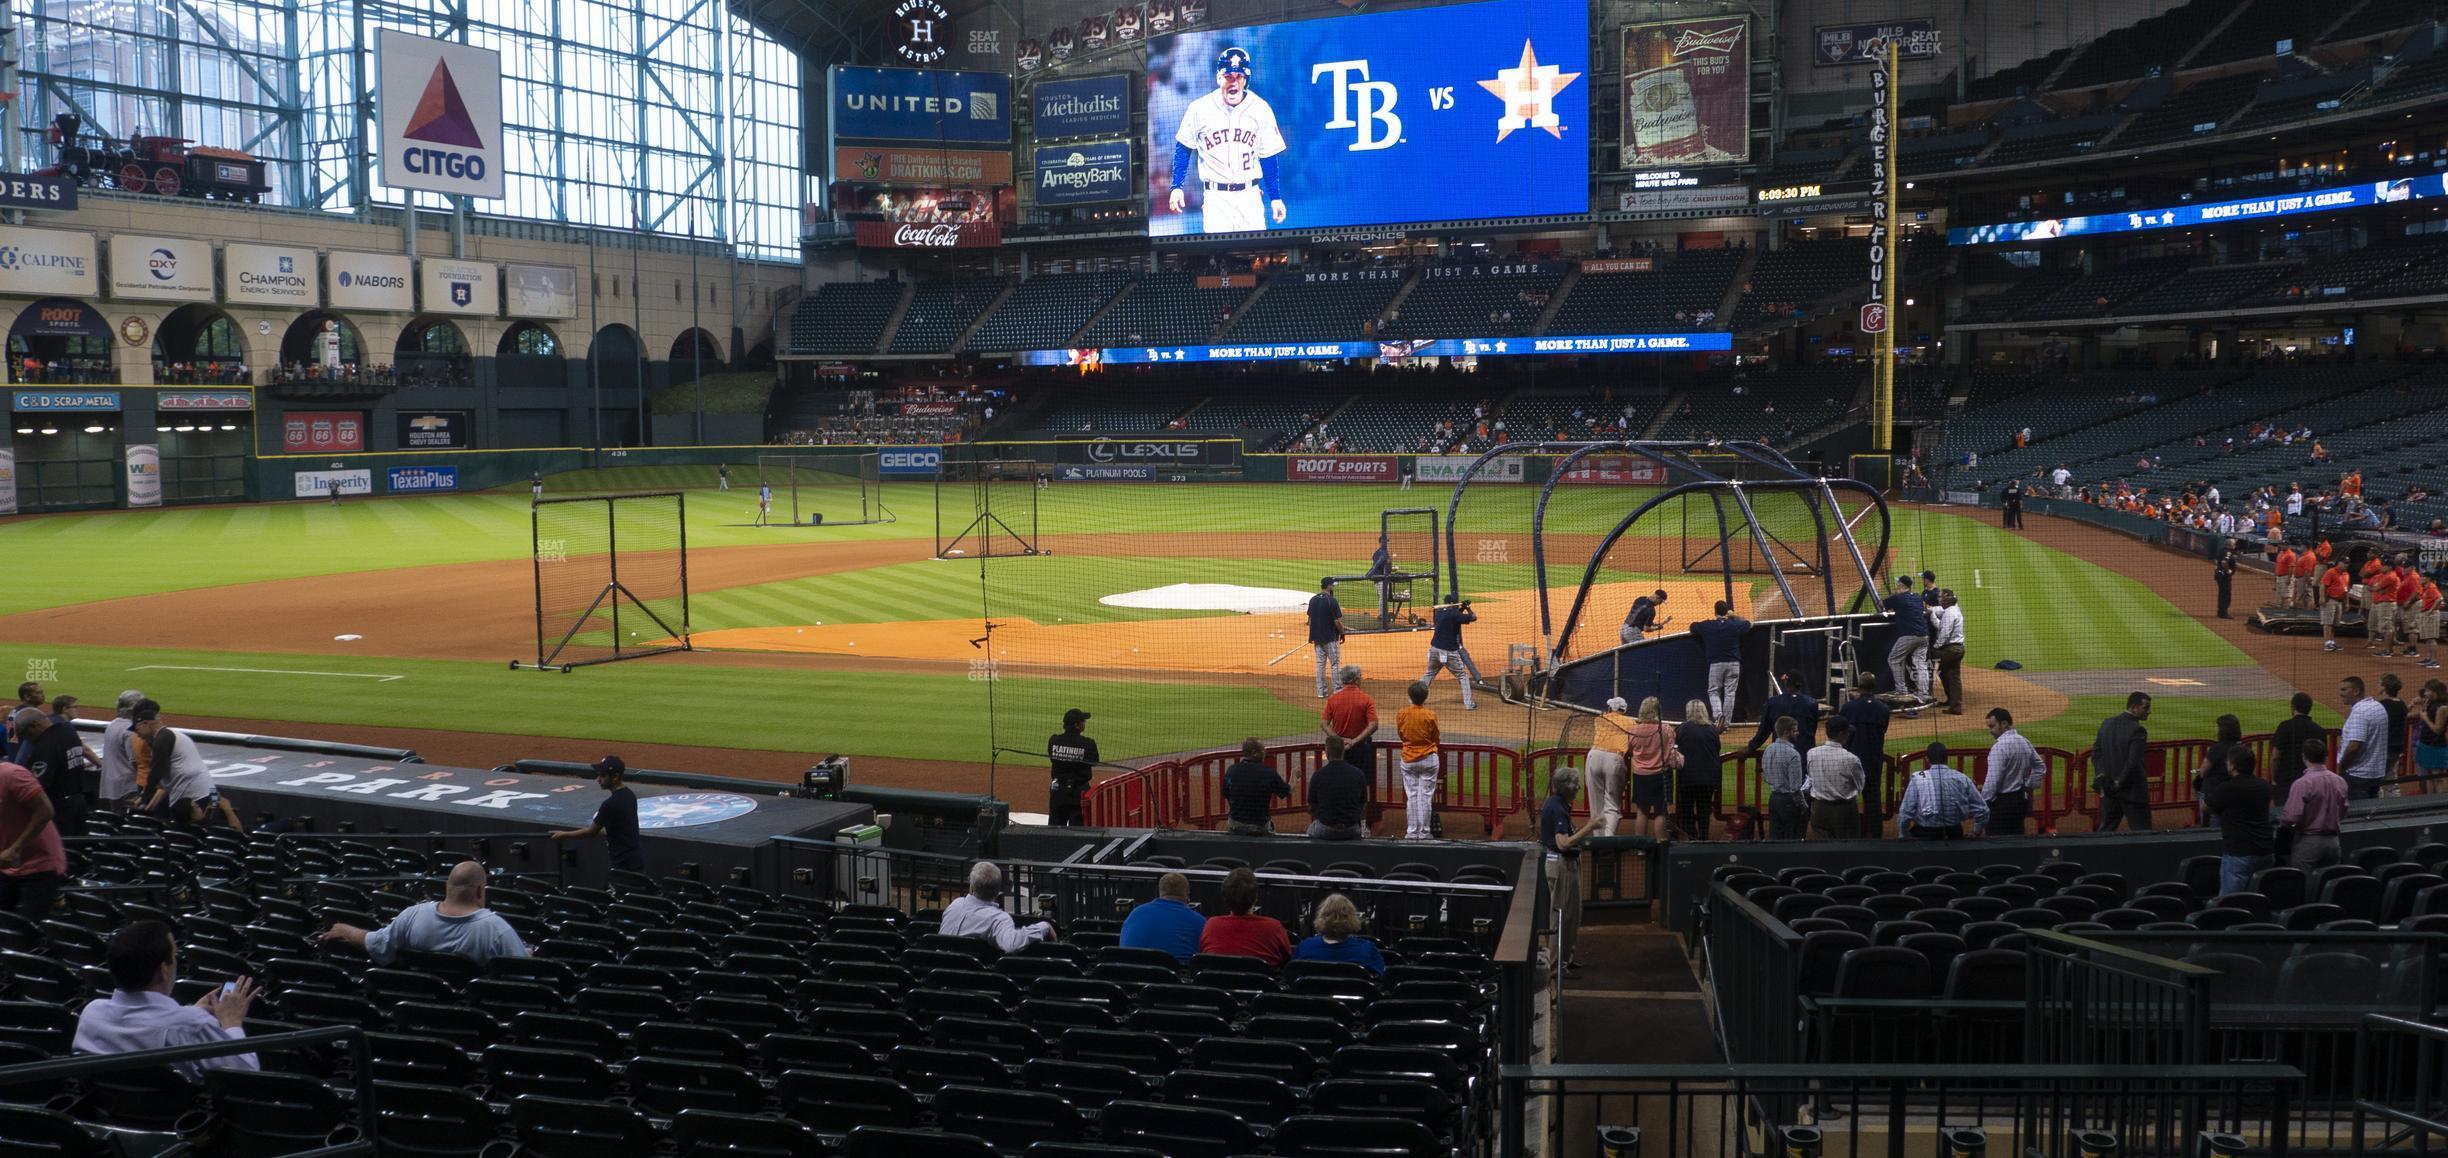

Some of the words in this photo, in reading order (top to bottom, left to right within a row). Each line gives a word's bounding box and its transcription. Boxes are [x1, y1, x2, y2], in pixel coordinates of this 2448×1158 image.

[895, 0, 948, 19] HOUSTON
[1115, 7, 1138, 27] 33
[911, 20, 932, 42] H
[1674, 35, 1740, 48] Budweiser
[898, 45, 945, 62] ASTROS
[1693, 57, 1708, 66] THIS
[1710, 56, 1730, 65] BUD'S
[1697, 66, 1711, 75] FOR
[1712, 65, 1725, 74] YOU
[847, 93, 963, 113] UNITED
[1041, 94, 1121, 117] Methodist
[1311, 59, 1403, 151] TB
[1204, 129, 1257, 151] ASTROS
[1869, 72, 1889, 195] BURGERZ
[403, 146, 485, 181] CITGO
[891, 153, 907, 163] FREE
[908, 155, 924, 165] Daily
[1042, 166, 1122, 189] AmegyBank
[1759, 188, 1799, 201] 6:09:30
[1800, 185, 1821, 198] PM
[2201, 204, 2240, 220] MORE
[2241, 201, 2274, 215] THAN
[2275, 197, 2305, 214] JUST
[2304, 196, 2314, 208] A
[2315, 191, 2356, 206] GAME.
[894, 223, 961, 248] Coca-Cola
[1311, 231, 1406, 243] DAKTRONICS
[22, 253, 85, 269] CALPINE
[149, 260, 177, 269] OXY
[1590, 263, 1604, 271] ALL
[1605, 263, 1619, 271] YOU
[1620, 262, 1634, 271] CAN
[1636, 262, 1650, 270] EAT
[1869, 227, 1885, 300] FOUL
[240, 272, 305, 287] CHAMPION
[1305, 272, 1350, 282] MORE
[1359, 270, 1401, 280] THAN
[1426, 266, 1462, 278] JUST
[1472, 267, 1481, 276] A
[355, 274, 404, 289] NABORS
[240, 286, 269, 294] ENERGY
[271, 287, 306, 296] SERVICES
[41, 308, 82, 321] ROOT
[1535, 340, 1573, 351] MORE
[1575, 339, 1608, 350] THAN
[1610, 339, 1636, 351] JUST
[1636, 339, 1646, 348] A
[1647, 337, 1690, 348] GAME.
[1209, 348, 1242, 358] MORE
[1244, 347, 1272, 357] THAN
[1273, 347, 1296, 358] JUST
[1297, 347, 1305, 356] A
[1306, 345, 1343, 356] GAME.
[21, 396, 29, 406] C
[31, 397, 39, 406] &
[41, 396, 50, 406] D
[54, 396, 83, 406] SCRAP
[86, 396, 113, 406] METAL
[904, 404, 954, 415] Budweiser
[289, 431, 303, 440] 66
[315, 430, 329, 440] 66
[341, 430, 354, 440] 66
[1120, 444, 1199, 457] LEXUS
[881, 452, 939, 466] GEICO
[1297, 459, 1337, 472] ROOT
[1338, 461, 1388, 473] SPORTS
[1086, 469, 1121, 478] PLATINUM
[1123, 469, 1147, 478] POOLS
[1421, 465, 1453, 474] EVA
[391, 472, 454, 489] TexanPlus
[1052, 745, 1085, 755] PLATINUM
[276, 772, 550, 809] PARK
